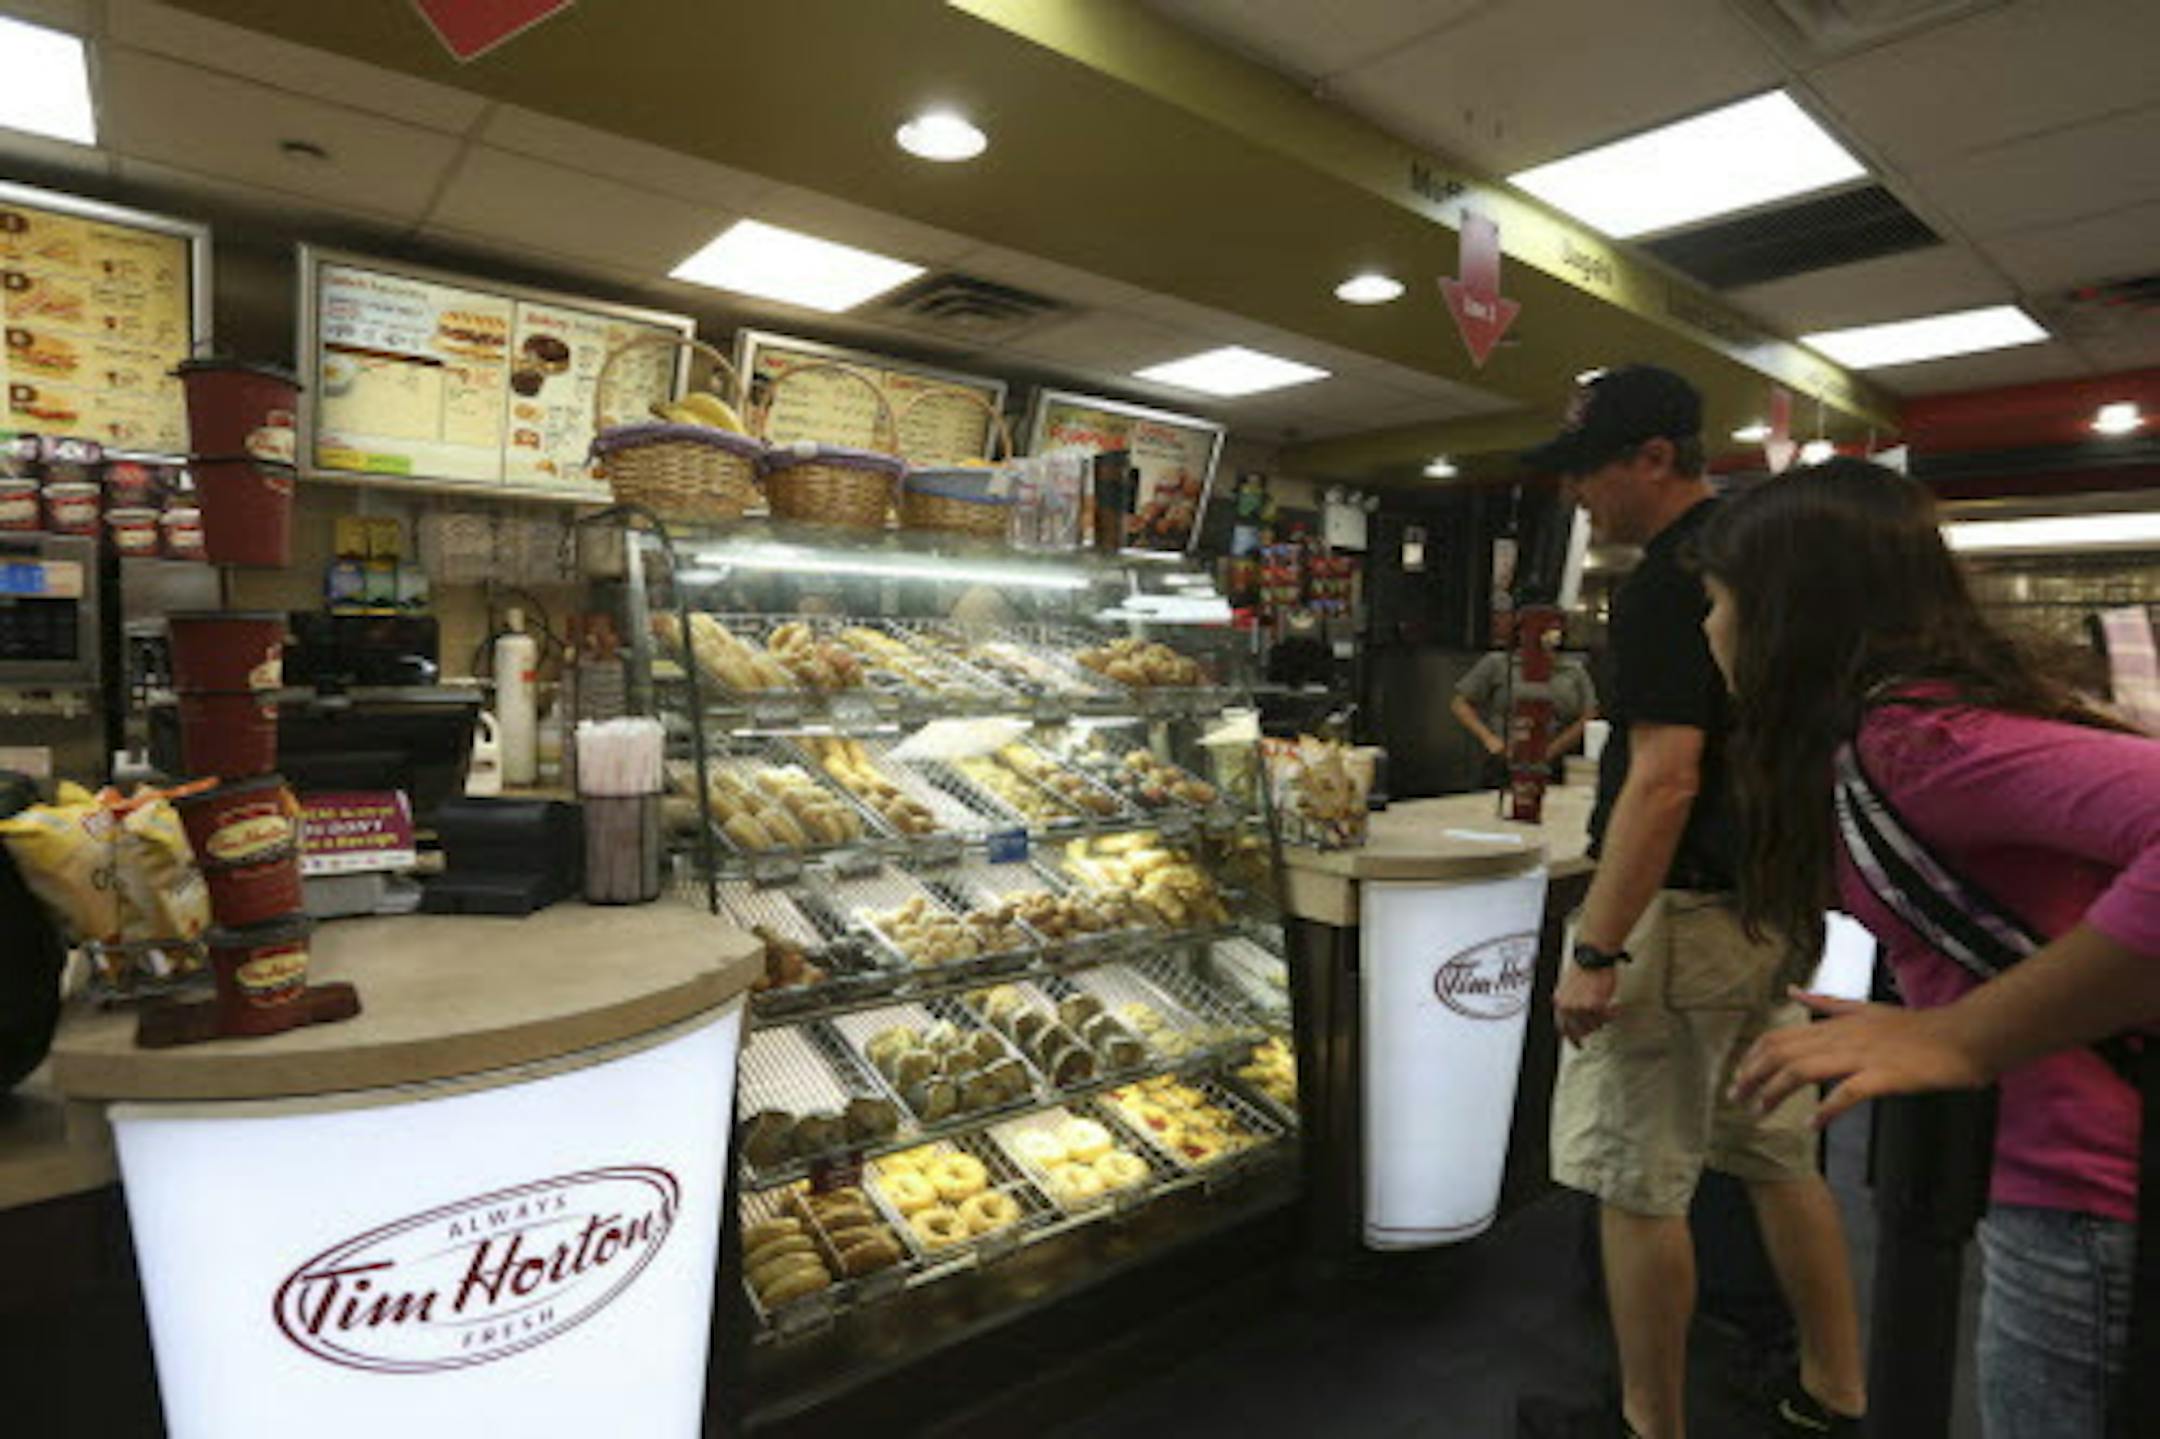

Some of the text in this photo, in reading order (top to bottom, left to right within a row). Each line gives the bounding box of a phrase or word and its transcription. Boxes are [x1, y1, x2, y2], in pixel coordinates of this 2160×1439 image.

[449, 1194, 567, 1239] ALWAYS
[303, 1260, 438, 1335] Tim
[461, 1306, 555, 1349] FRESH
